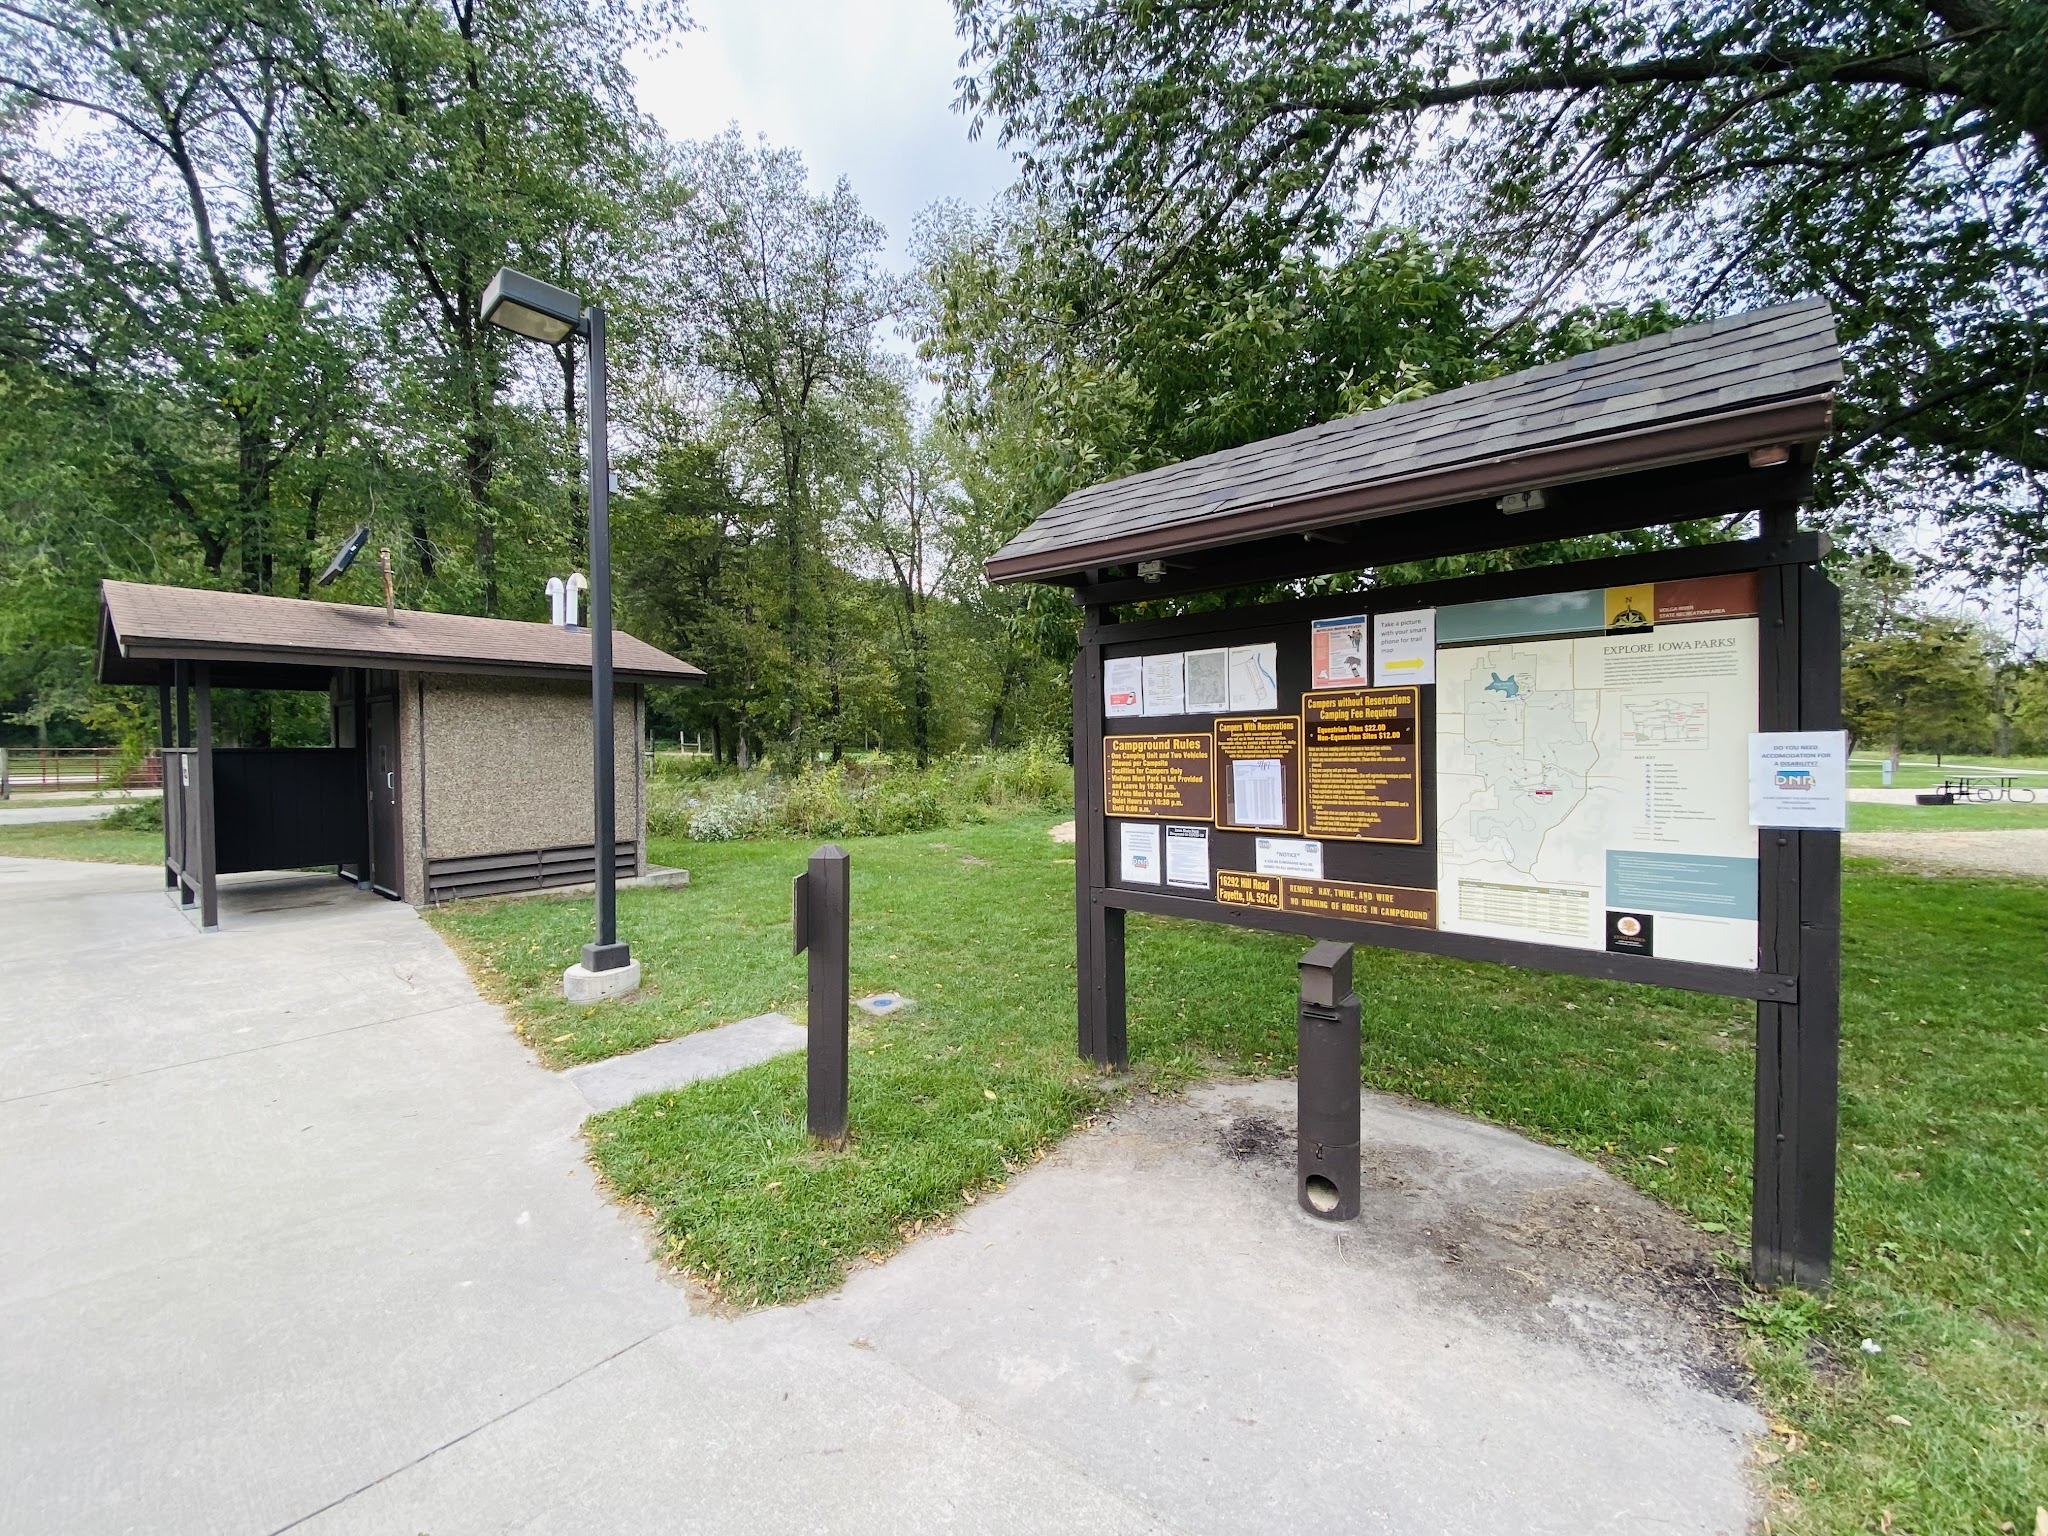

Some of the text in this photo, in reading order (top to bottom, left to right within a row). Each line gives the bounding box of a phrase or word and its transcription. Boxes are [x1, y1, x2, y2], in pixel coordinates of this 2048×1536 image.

[1676, 610, 1710, 618] RECREATION
[1401, 619, 1421, 627] picture
[1381, 638, 1399, 646] phone
[1604, 638, 1736, 655] EXPLORE IOWA PARKS!
[1308, 694, 1411, 709] Campers without Reservations
[1321, 707, 1397, 721] Camping Fee Required
[1220, 721, 1294, 732] Campers With Reservations
[1318, 726, 1347, 734] Equestrian
[1318, 734, 1361, 742] Non-Equestrian
[1113, 739, 1200, 752] Campground Rules
[1775, 775, 1816, 786] DNR
[1220, 875, 1239, 888] 16292
[1240, 878, 1251, 889] Hill
[1253, 879, 1269, 891] Road
[1220, 889, 1278, 905] Fayette, IA. 52142
[1290, 885, 1394, 903] REMOVE HAY, TWINE, AND WIRE
[1290, 898, 1428, 920] NO RUNNING OF HORSES IN CAMPGROUND
